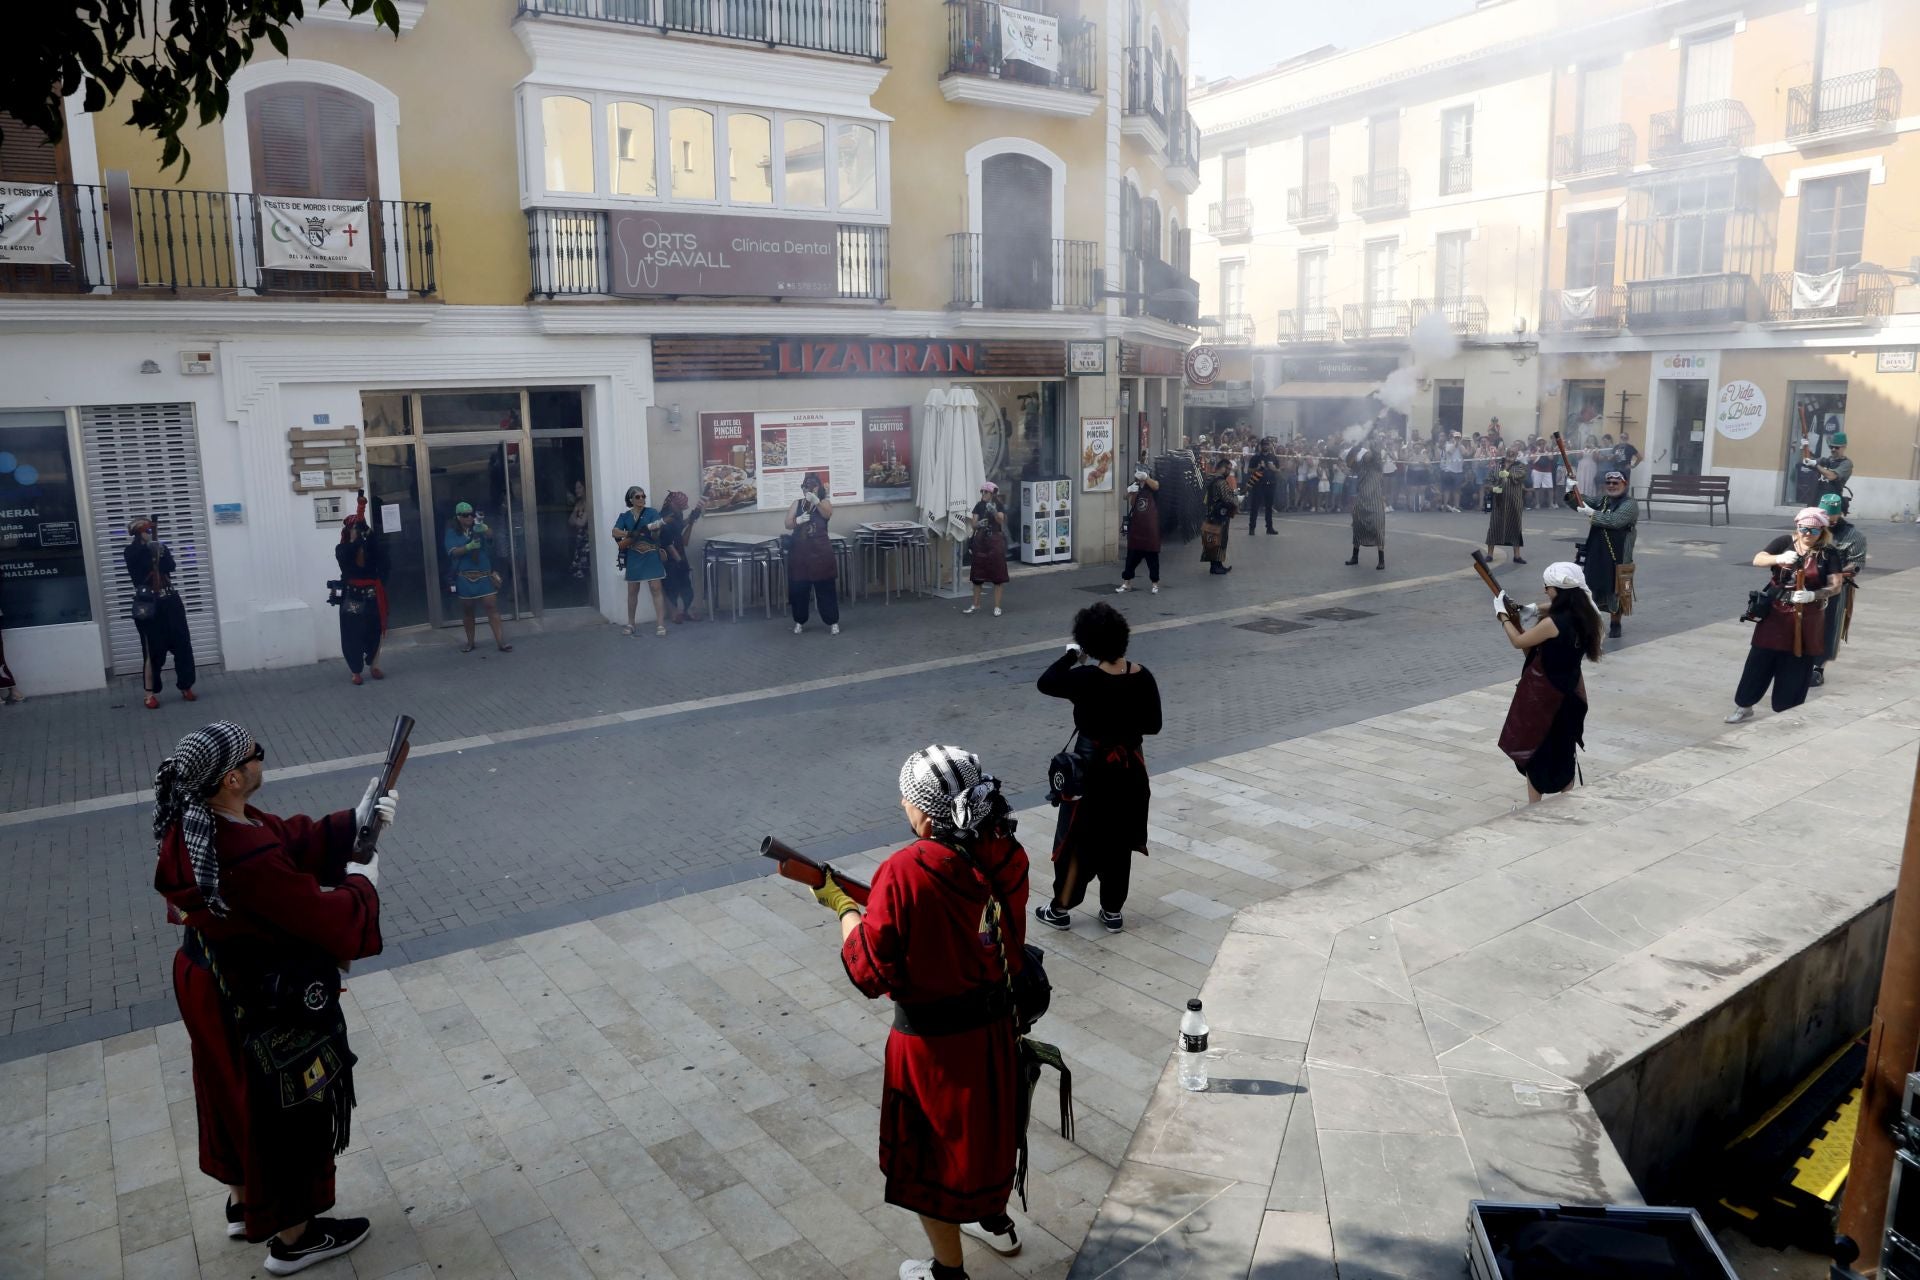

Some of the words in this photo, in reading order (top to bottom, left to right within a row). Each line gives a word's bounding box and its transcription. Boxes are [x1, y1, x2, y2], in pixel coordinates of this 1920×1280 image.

[14, 188, 53, 197] CRISTIANS
[642, 232, 696, 250] ORTS
[732, 238, 779, 253] Clínica
[784, 240, 831, 256] Dental
[644, 250, 730, 268] +SAVALL
[778, 342, 975, 373] LIZARRAN
[1727, 384, 1754, 402] Vida
[1728, 402, 1762, 420] Brian
[869, 422, 904, 431] CALENTITOS
